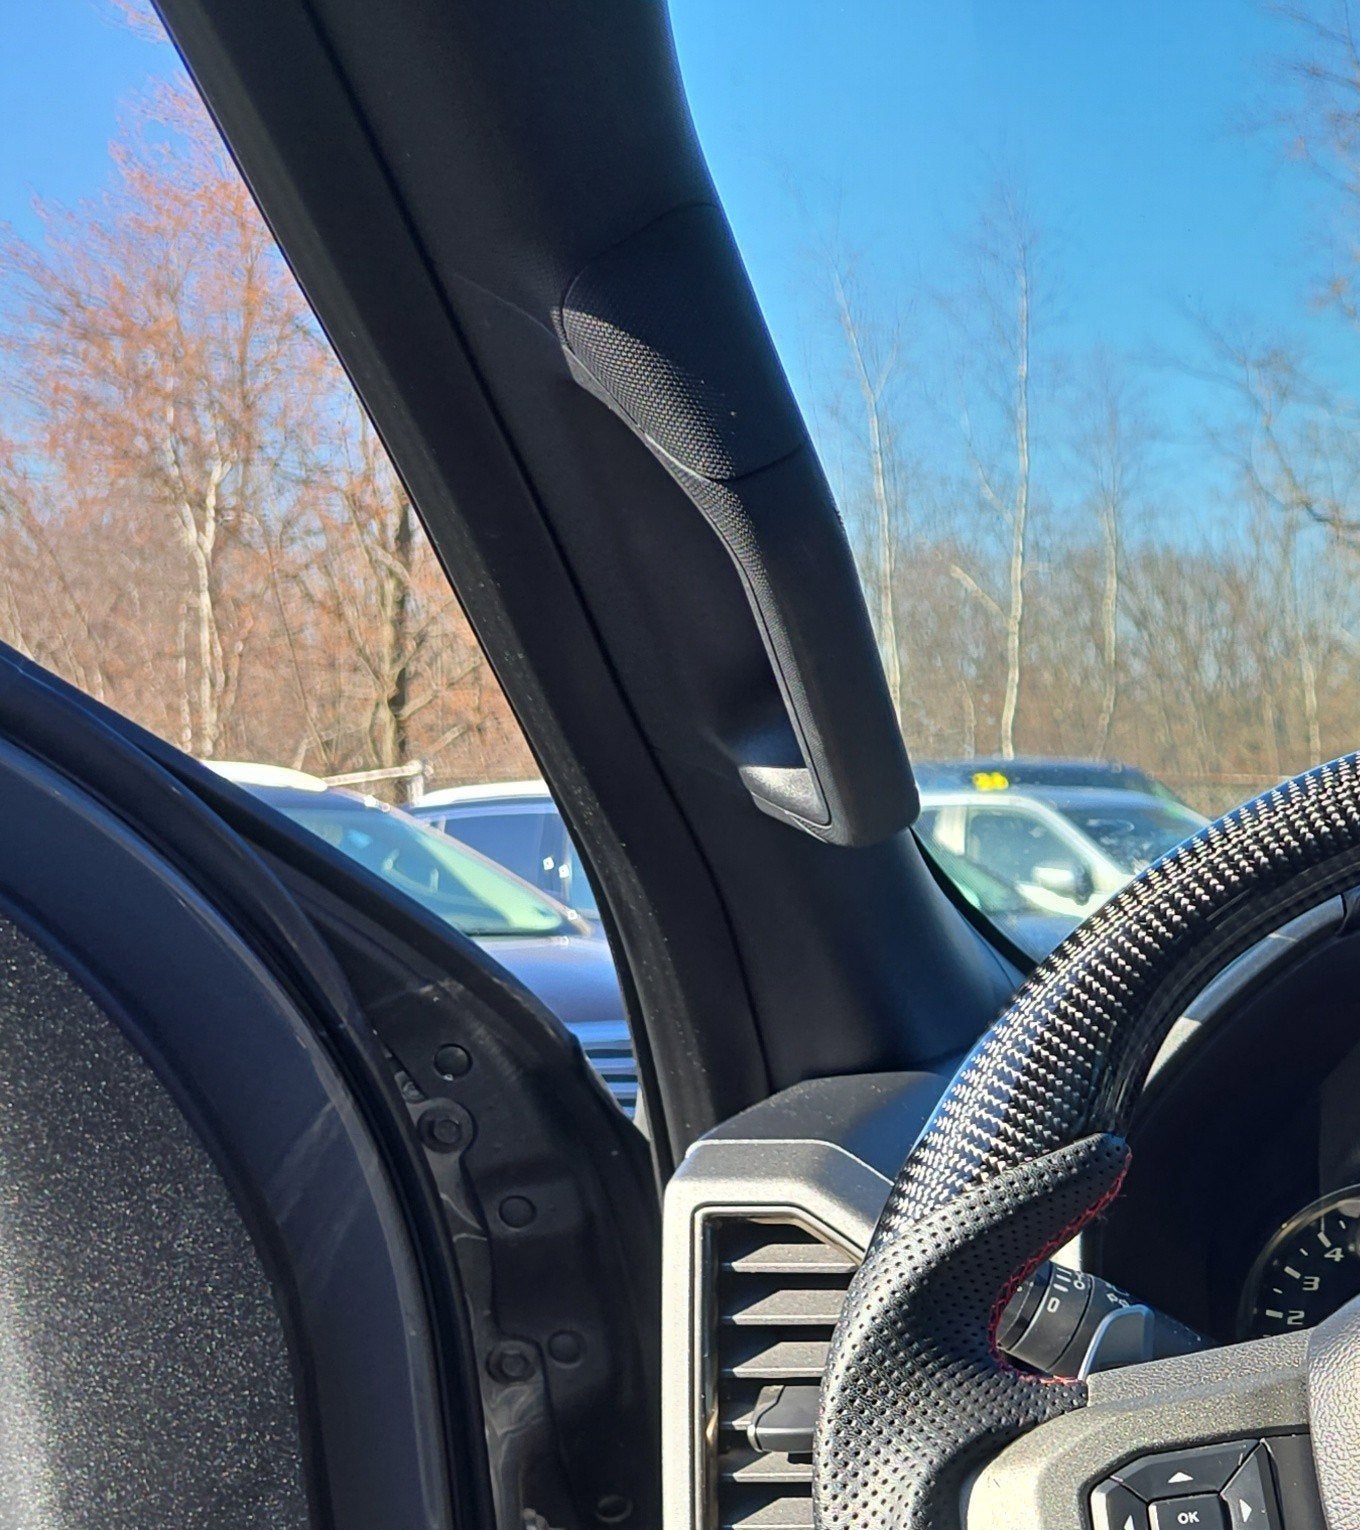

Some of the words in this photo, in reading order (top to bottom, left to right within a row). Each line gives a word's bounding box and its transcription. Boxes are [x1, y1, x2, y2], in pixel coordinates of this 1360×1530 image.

[1324, 1247, 1344, 1262] 4
[1302, 1276, 1320, 1291] 3
[1286, 1310, 1305, 1325] 2
[1177, 1511, 1200, 1525] OK
